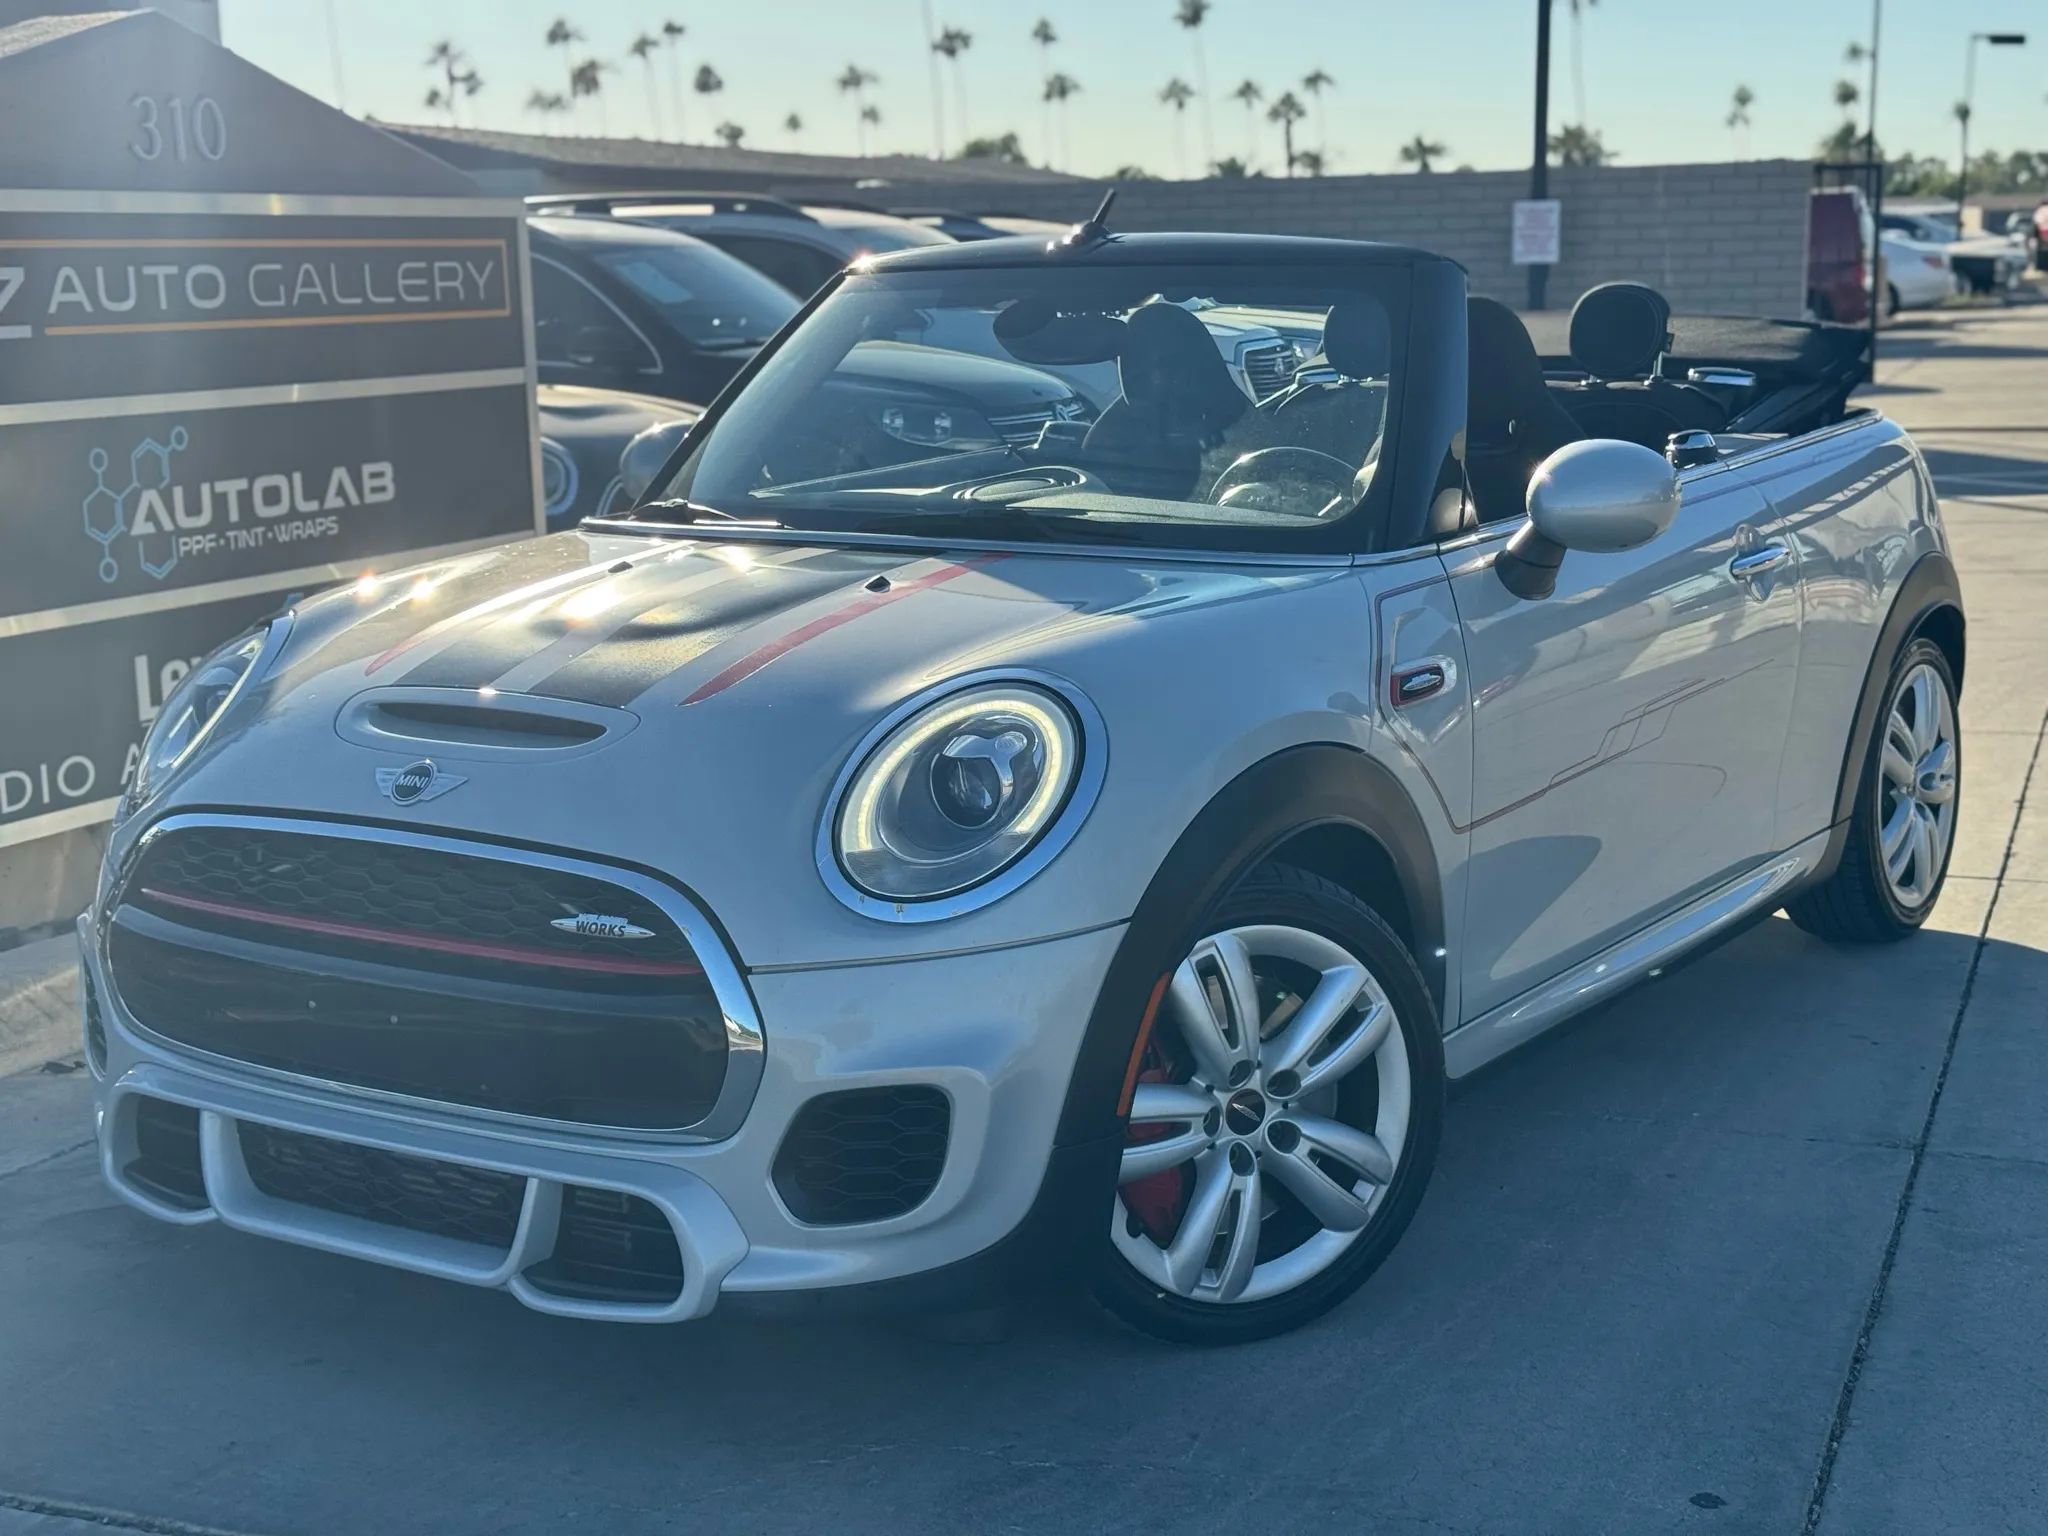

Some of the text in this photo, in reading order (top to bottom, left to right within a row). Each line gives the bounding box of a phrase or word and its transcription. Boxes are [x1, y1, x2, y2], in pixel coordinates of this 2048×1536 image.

[130, 95, 228, 163] 310
[47, 264, 226, 314] AUTO
[248, 261, 494, 307] GALLERY
[130, 461, 396, 536] AUTOLAB
[395, 774, 429, 788] MINI
[575, 920, 627, 937] WORKS
